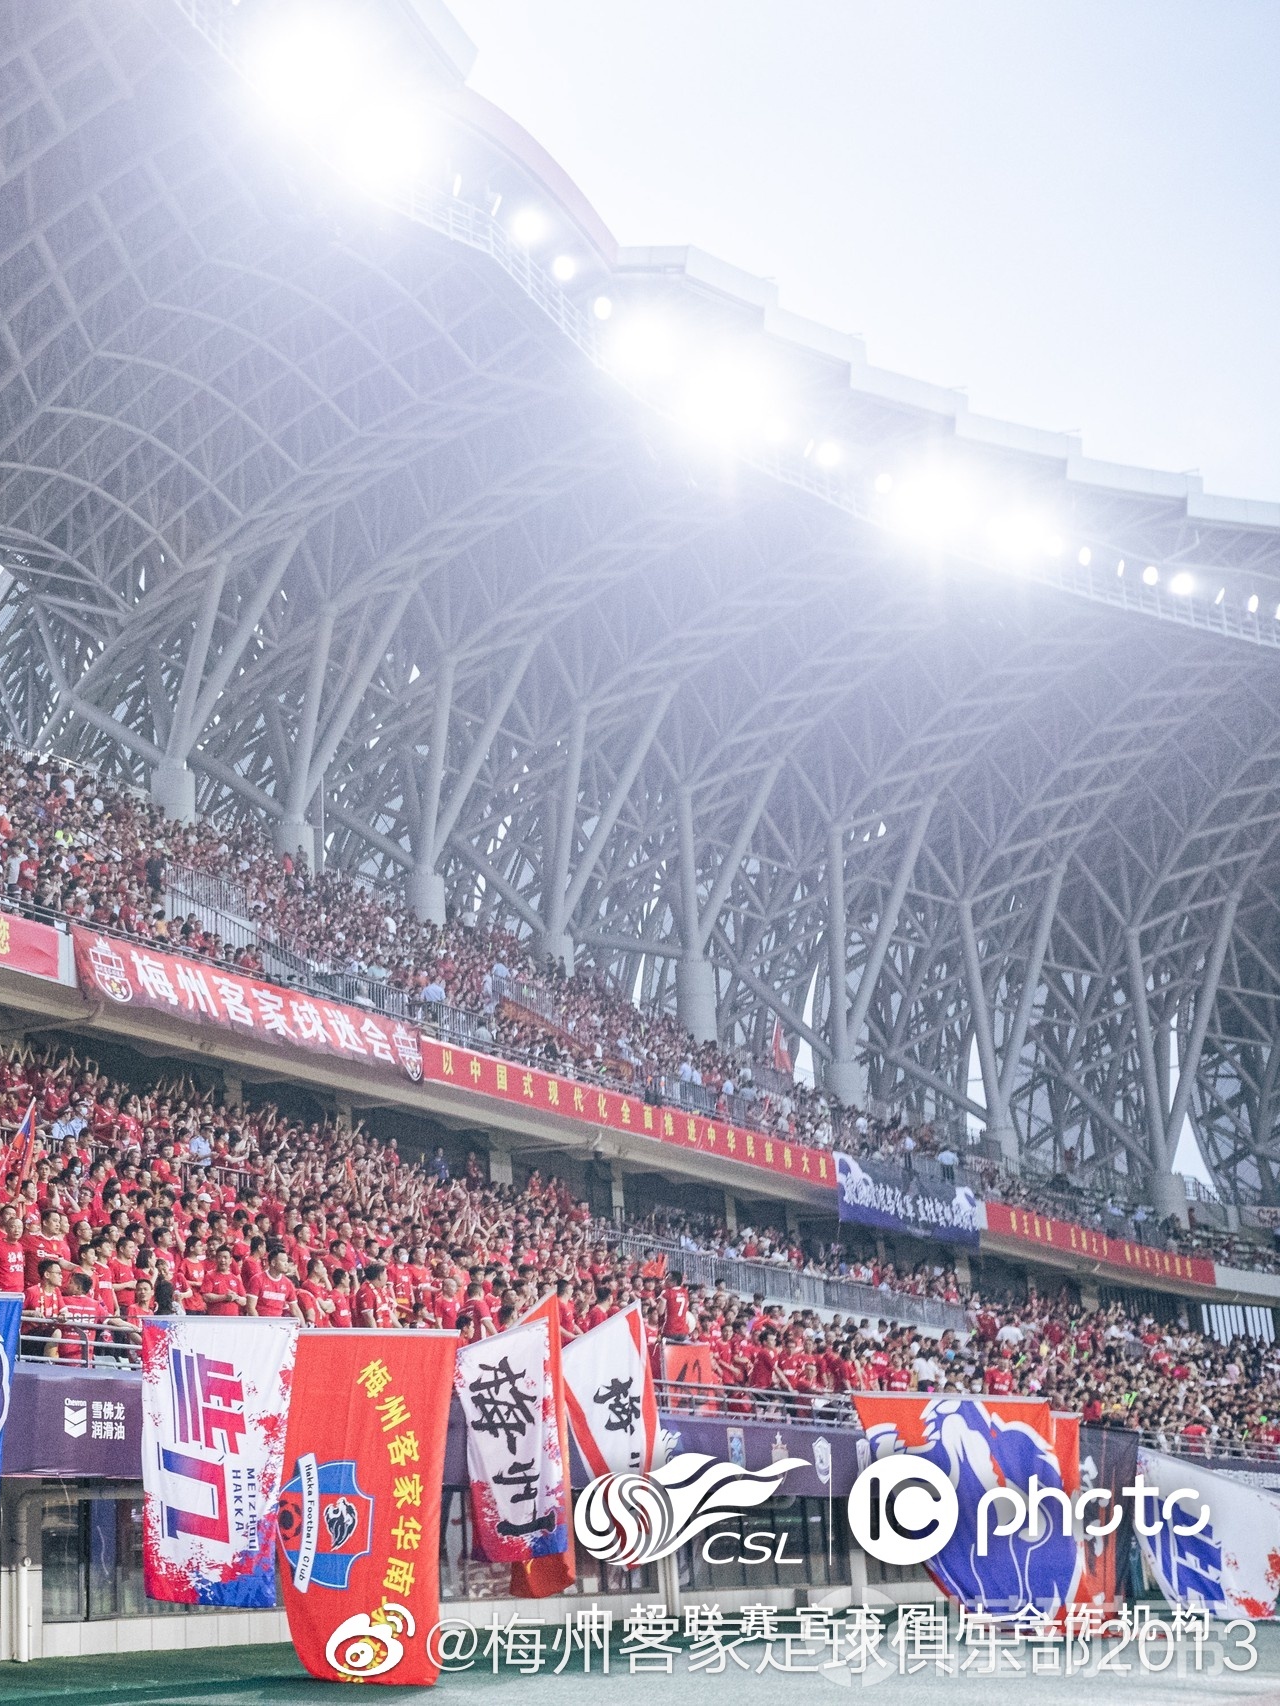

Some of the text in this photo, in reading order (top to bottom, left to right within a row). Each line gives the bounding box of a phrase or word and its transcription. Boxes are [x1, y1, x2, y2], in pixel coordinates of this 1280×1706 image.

[131, 950, 397, 1065] 梅州客家球迷会
[676, 1296, 686, 1317] 7
[91, 1401, 125, 1420] 雪佛龙
[91, 1421, 125, 1440] 润滑油
[231, 1469, 245, 1532] HAKKA
[297, 1463, 315, 1582] Hakka Football Club
